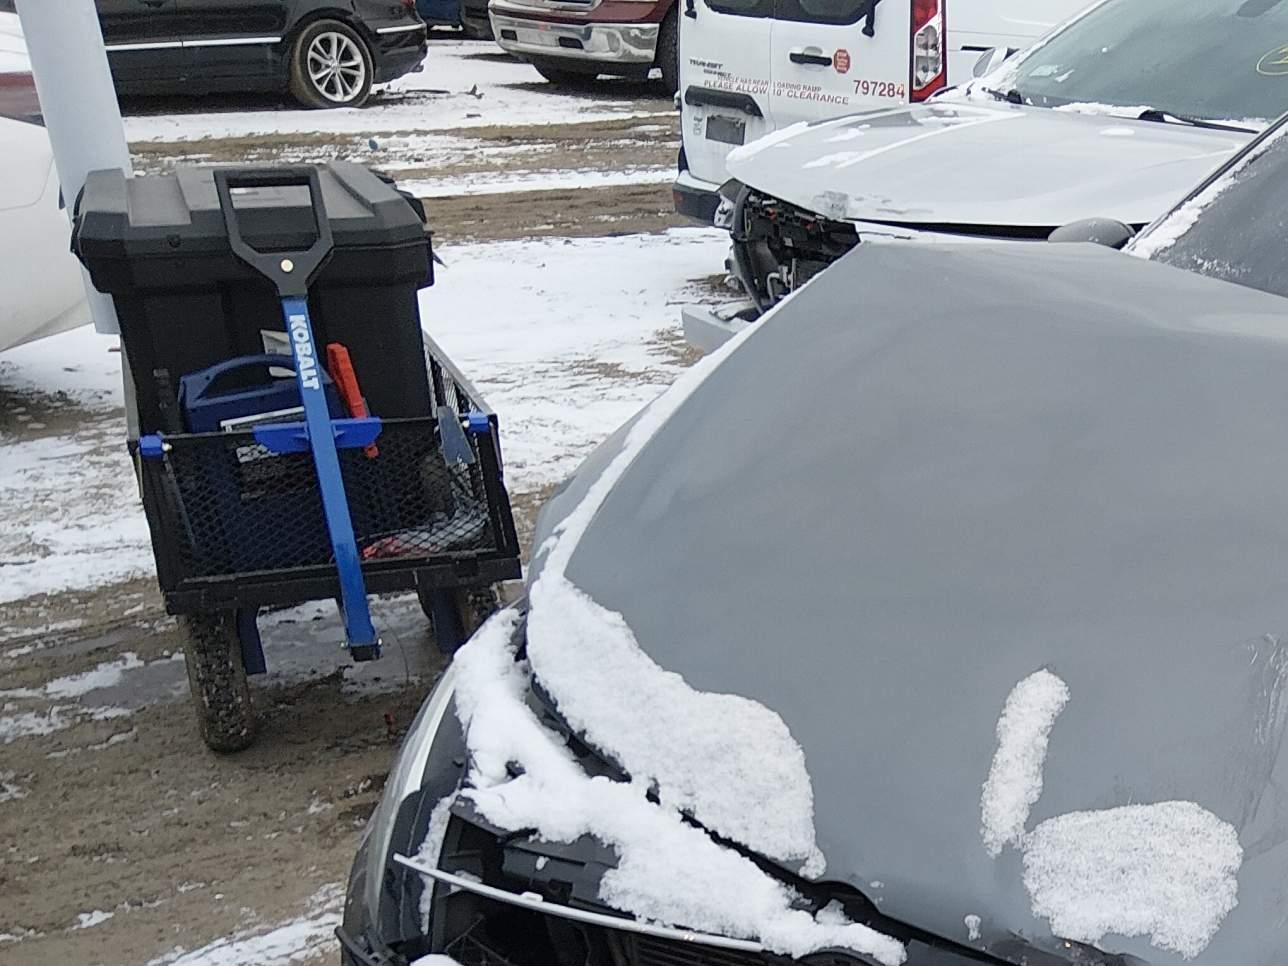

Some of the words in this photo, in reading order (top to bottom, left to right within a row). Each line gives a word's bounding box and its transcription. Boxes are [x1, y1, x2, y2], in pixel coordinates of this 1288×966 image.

[704, 80, 733, 90] PLEASE
[735, 84, 768, 95] ALLOW
[786, 90, 849, 105] CLEARANCE
[773, 81, 802, 92] LOADING
[803, 84, 822, 93] RAMP
[853, 79, 905, 99] 797284
[288, 314, 320, 390] KOBALT
